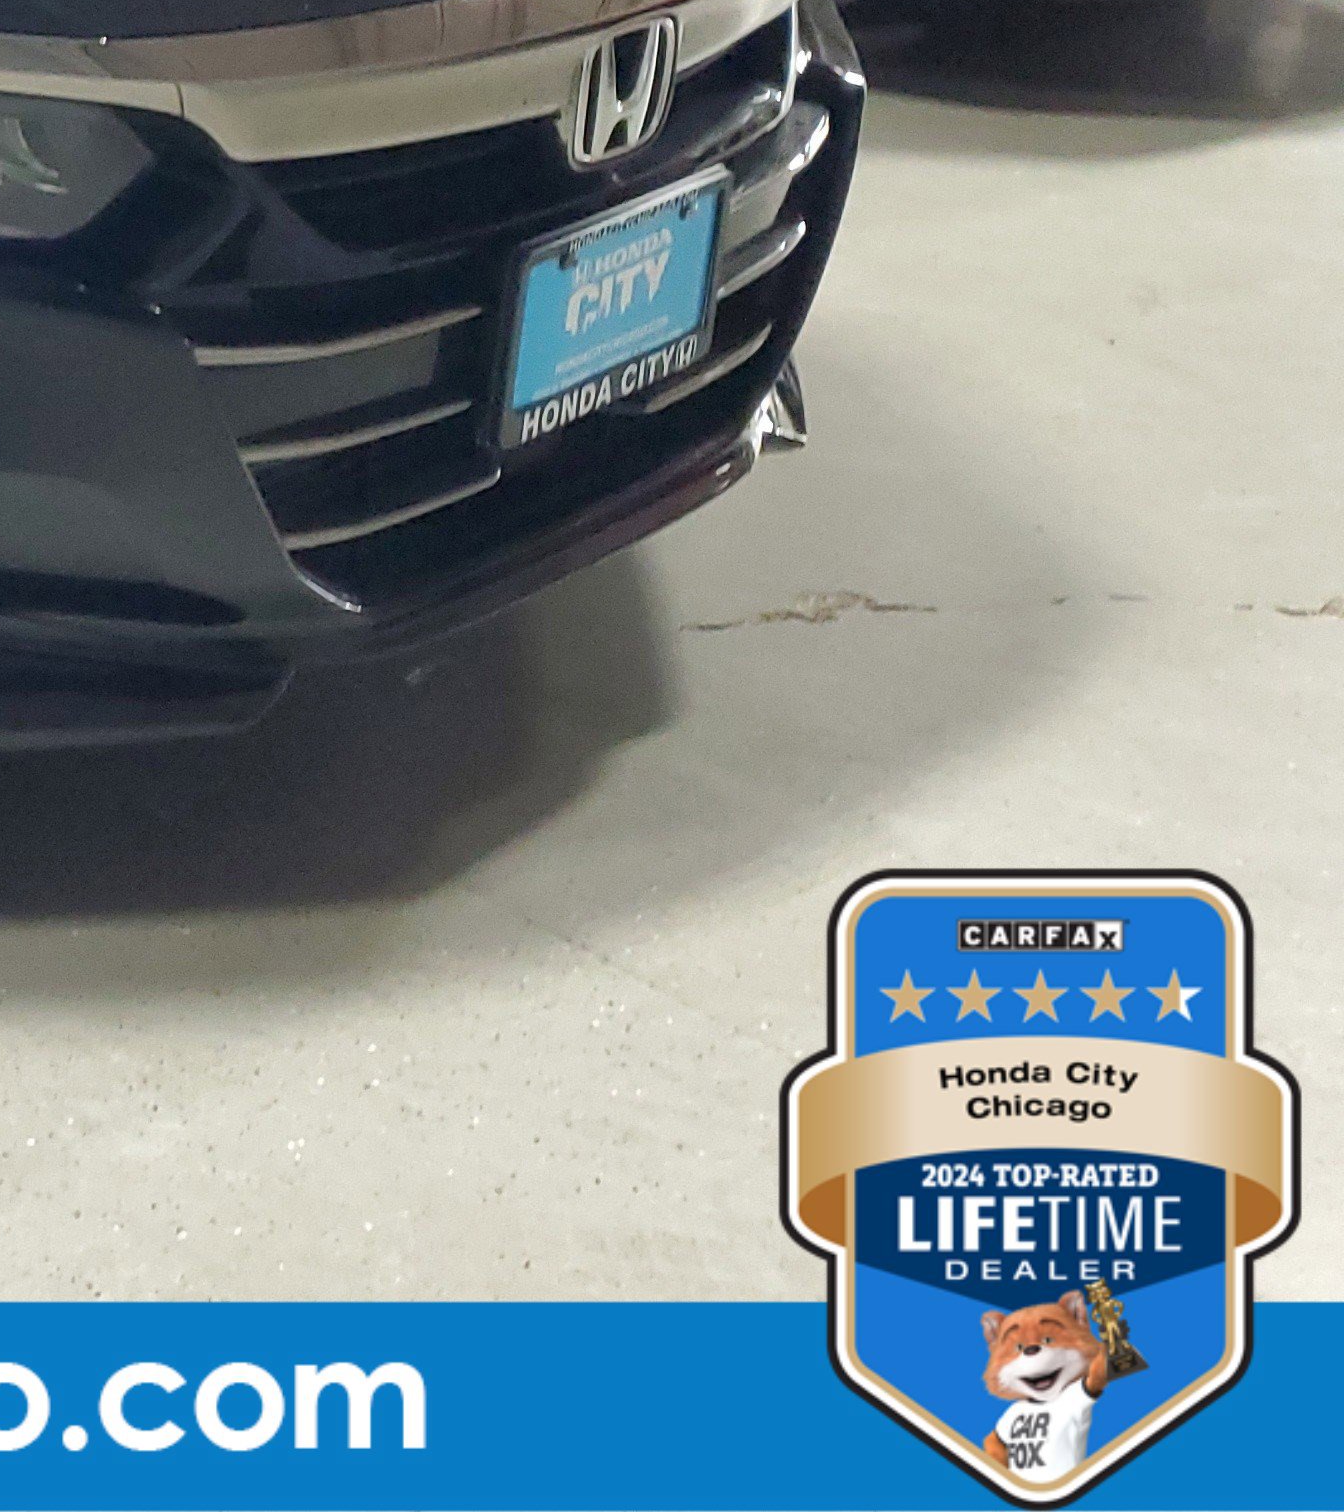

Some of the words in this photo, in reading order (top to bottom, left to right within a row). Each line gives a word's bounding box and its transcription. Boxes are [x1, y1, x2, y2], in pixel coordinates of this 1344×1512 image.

[565, 251, 670, 335] CITY
[594, 228, 673, 275] HONDA
[521, 374, 612, 445] HONDA
[620, 343, 678, 396] CITY
